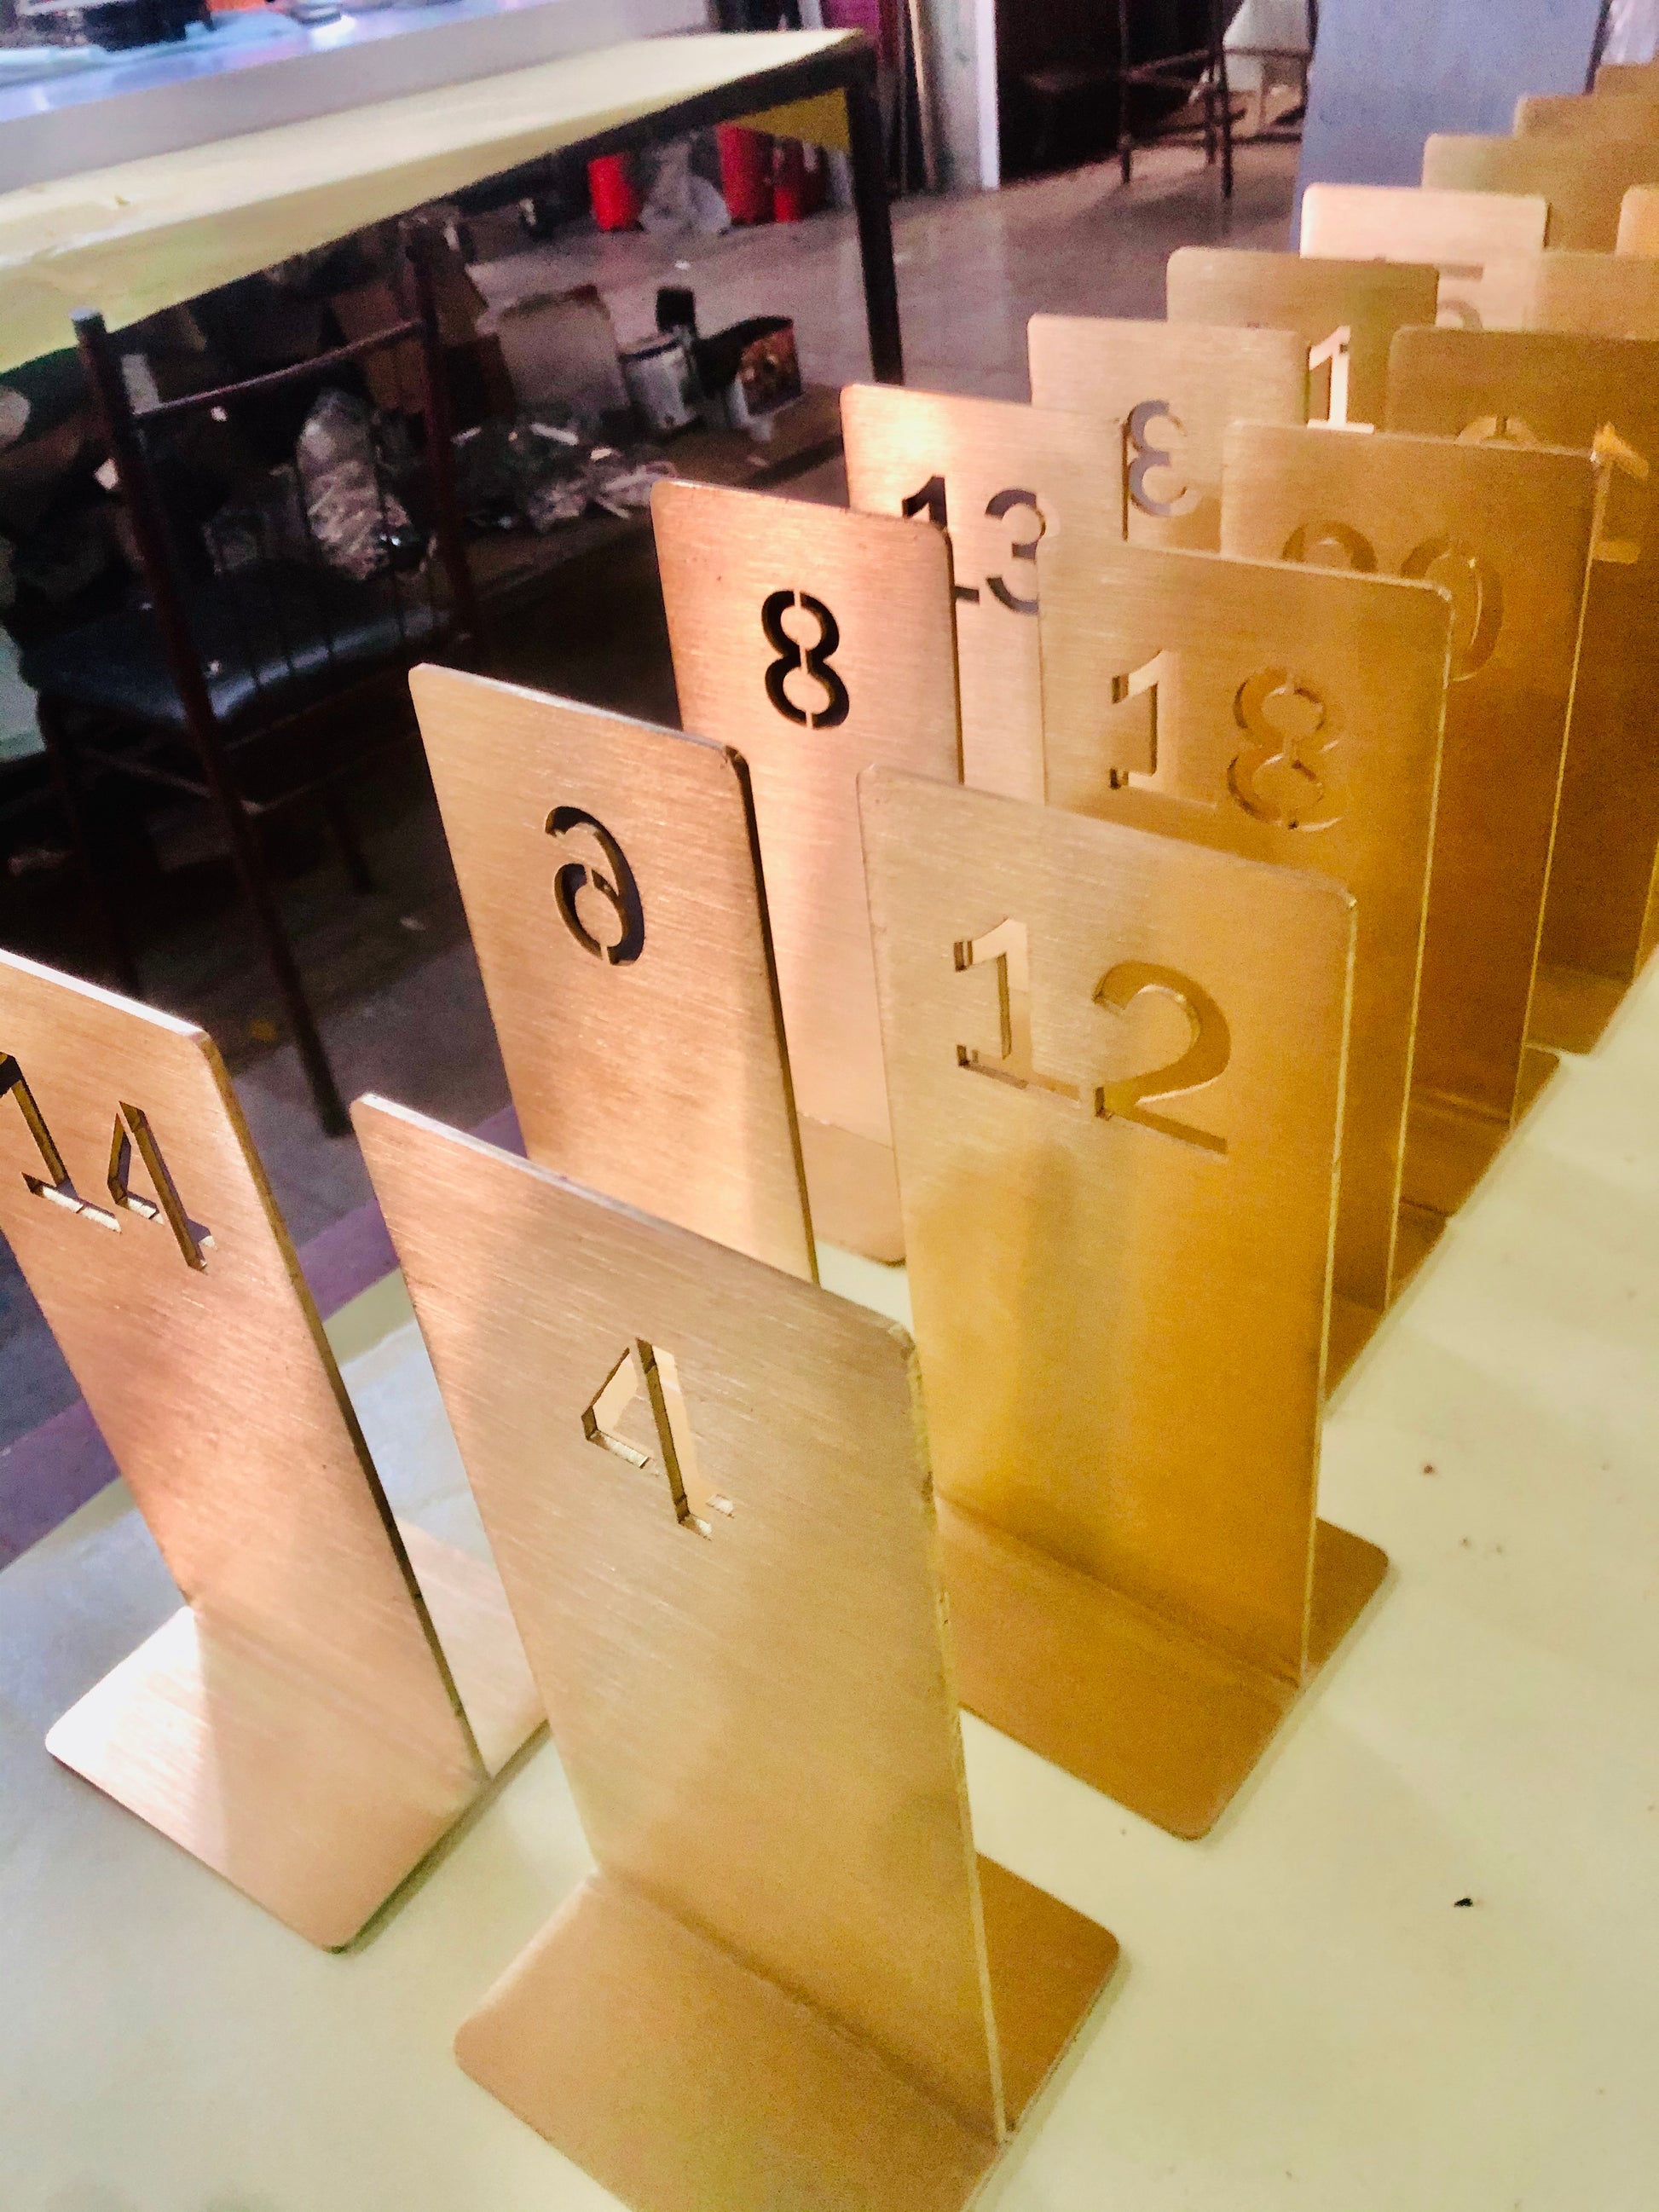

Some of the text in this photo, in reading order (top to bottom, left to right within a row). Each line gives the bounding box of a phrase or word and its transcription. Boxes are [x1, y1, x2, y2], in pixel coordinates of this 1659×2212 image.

[761, 589, 850, 730] 8
[1109, 649, 1344, 831] 18
[953, 916, 1231, 1164] 12
[0, 1051, 217, 1276] 14
[581, 1337, 735, 1541] 4
